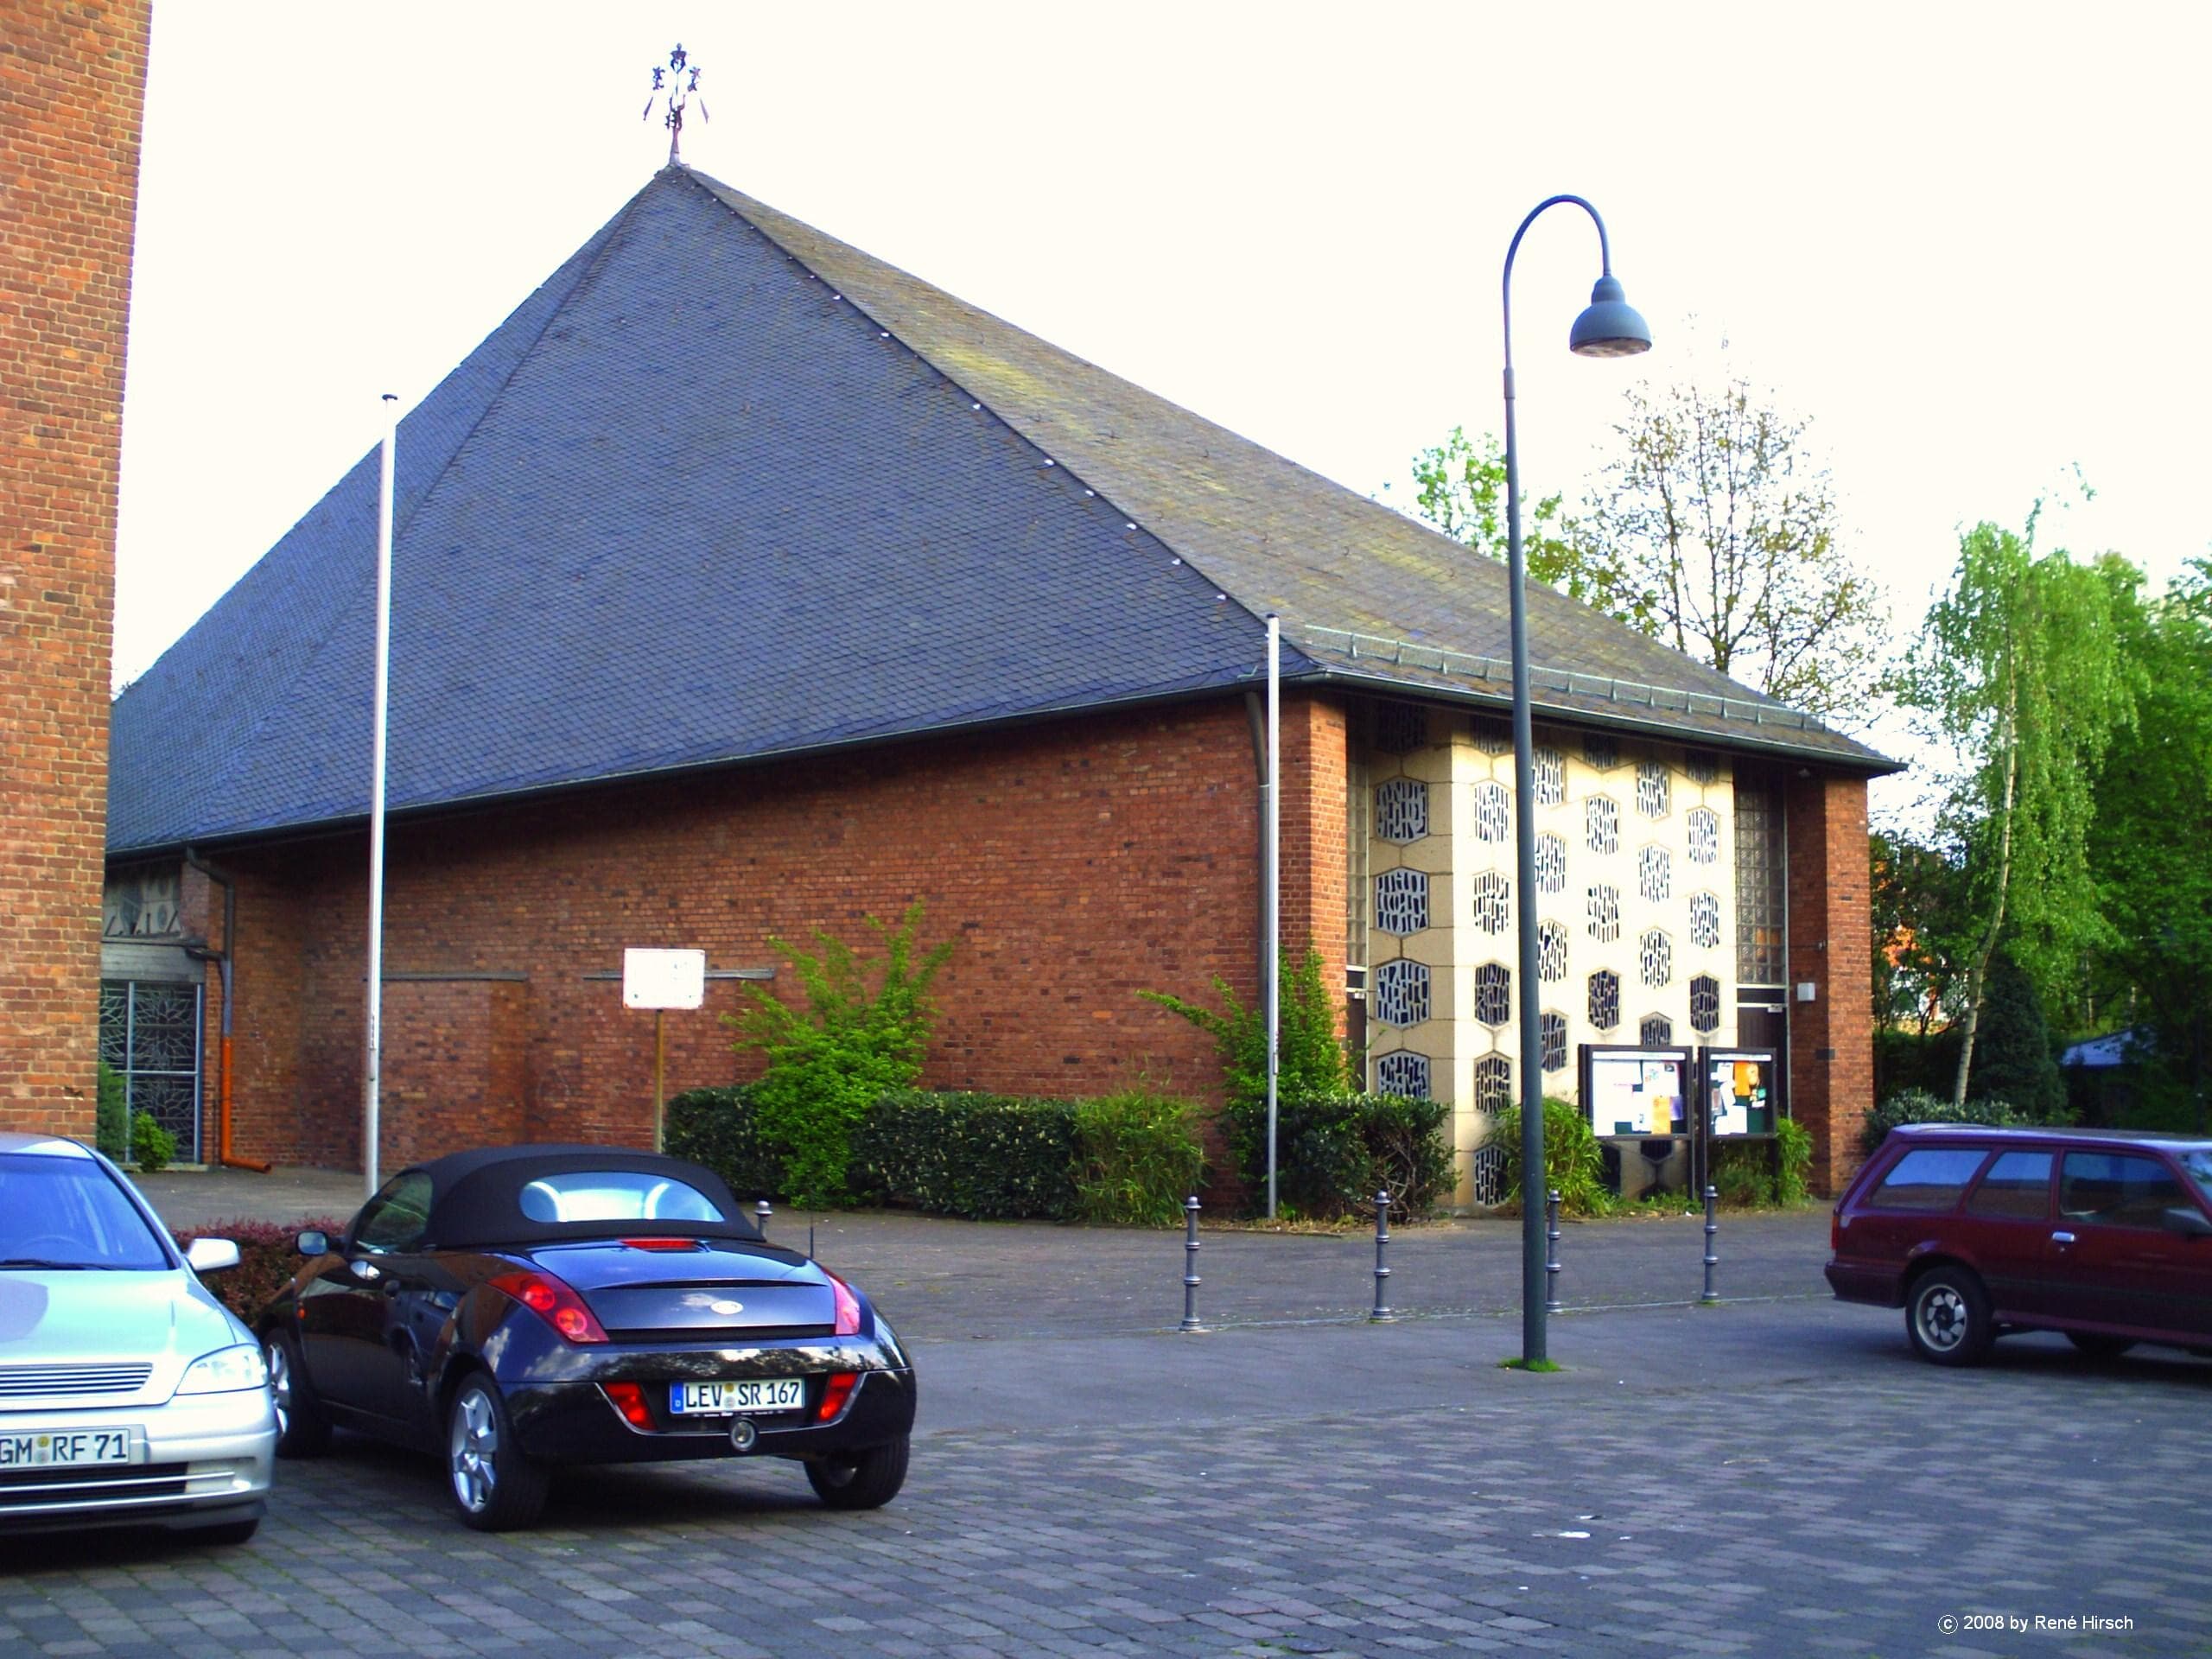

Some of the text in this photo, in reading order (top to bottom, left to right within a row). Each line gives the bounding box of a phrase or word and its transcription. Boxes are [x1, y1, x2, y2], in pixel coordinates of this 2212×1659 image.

[685, 1382, 800, 1408] LEV SR 167
[0, 1433, 127, 1464] GM RF 71
